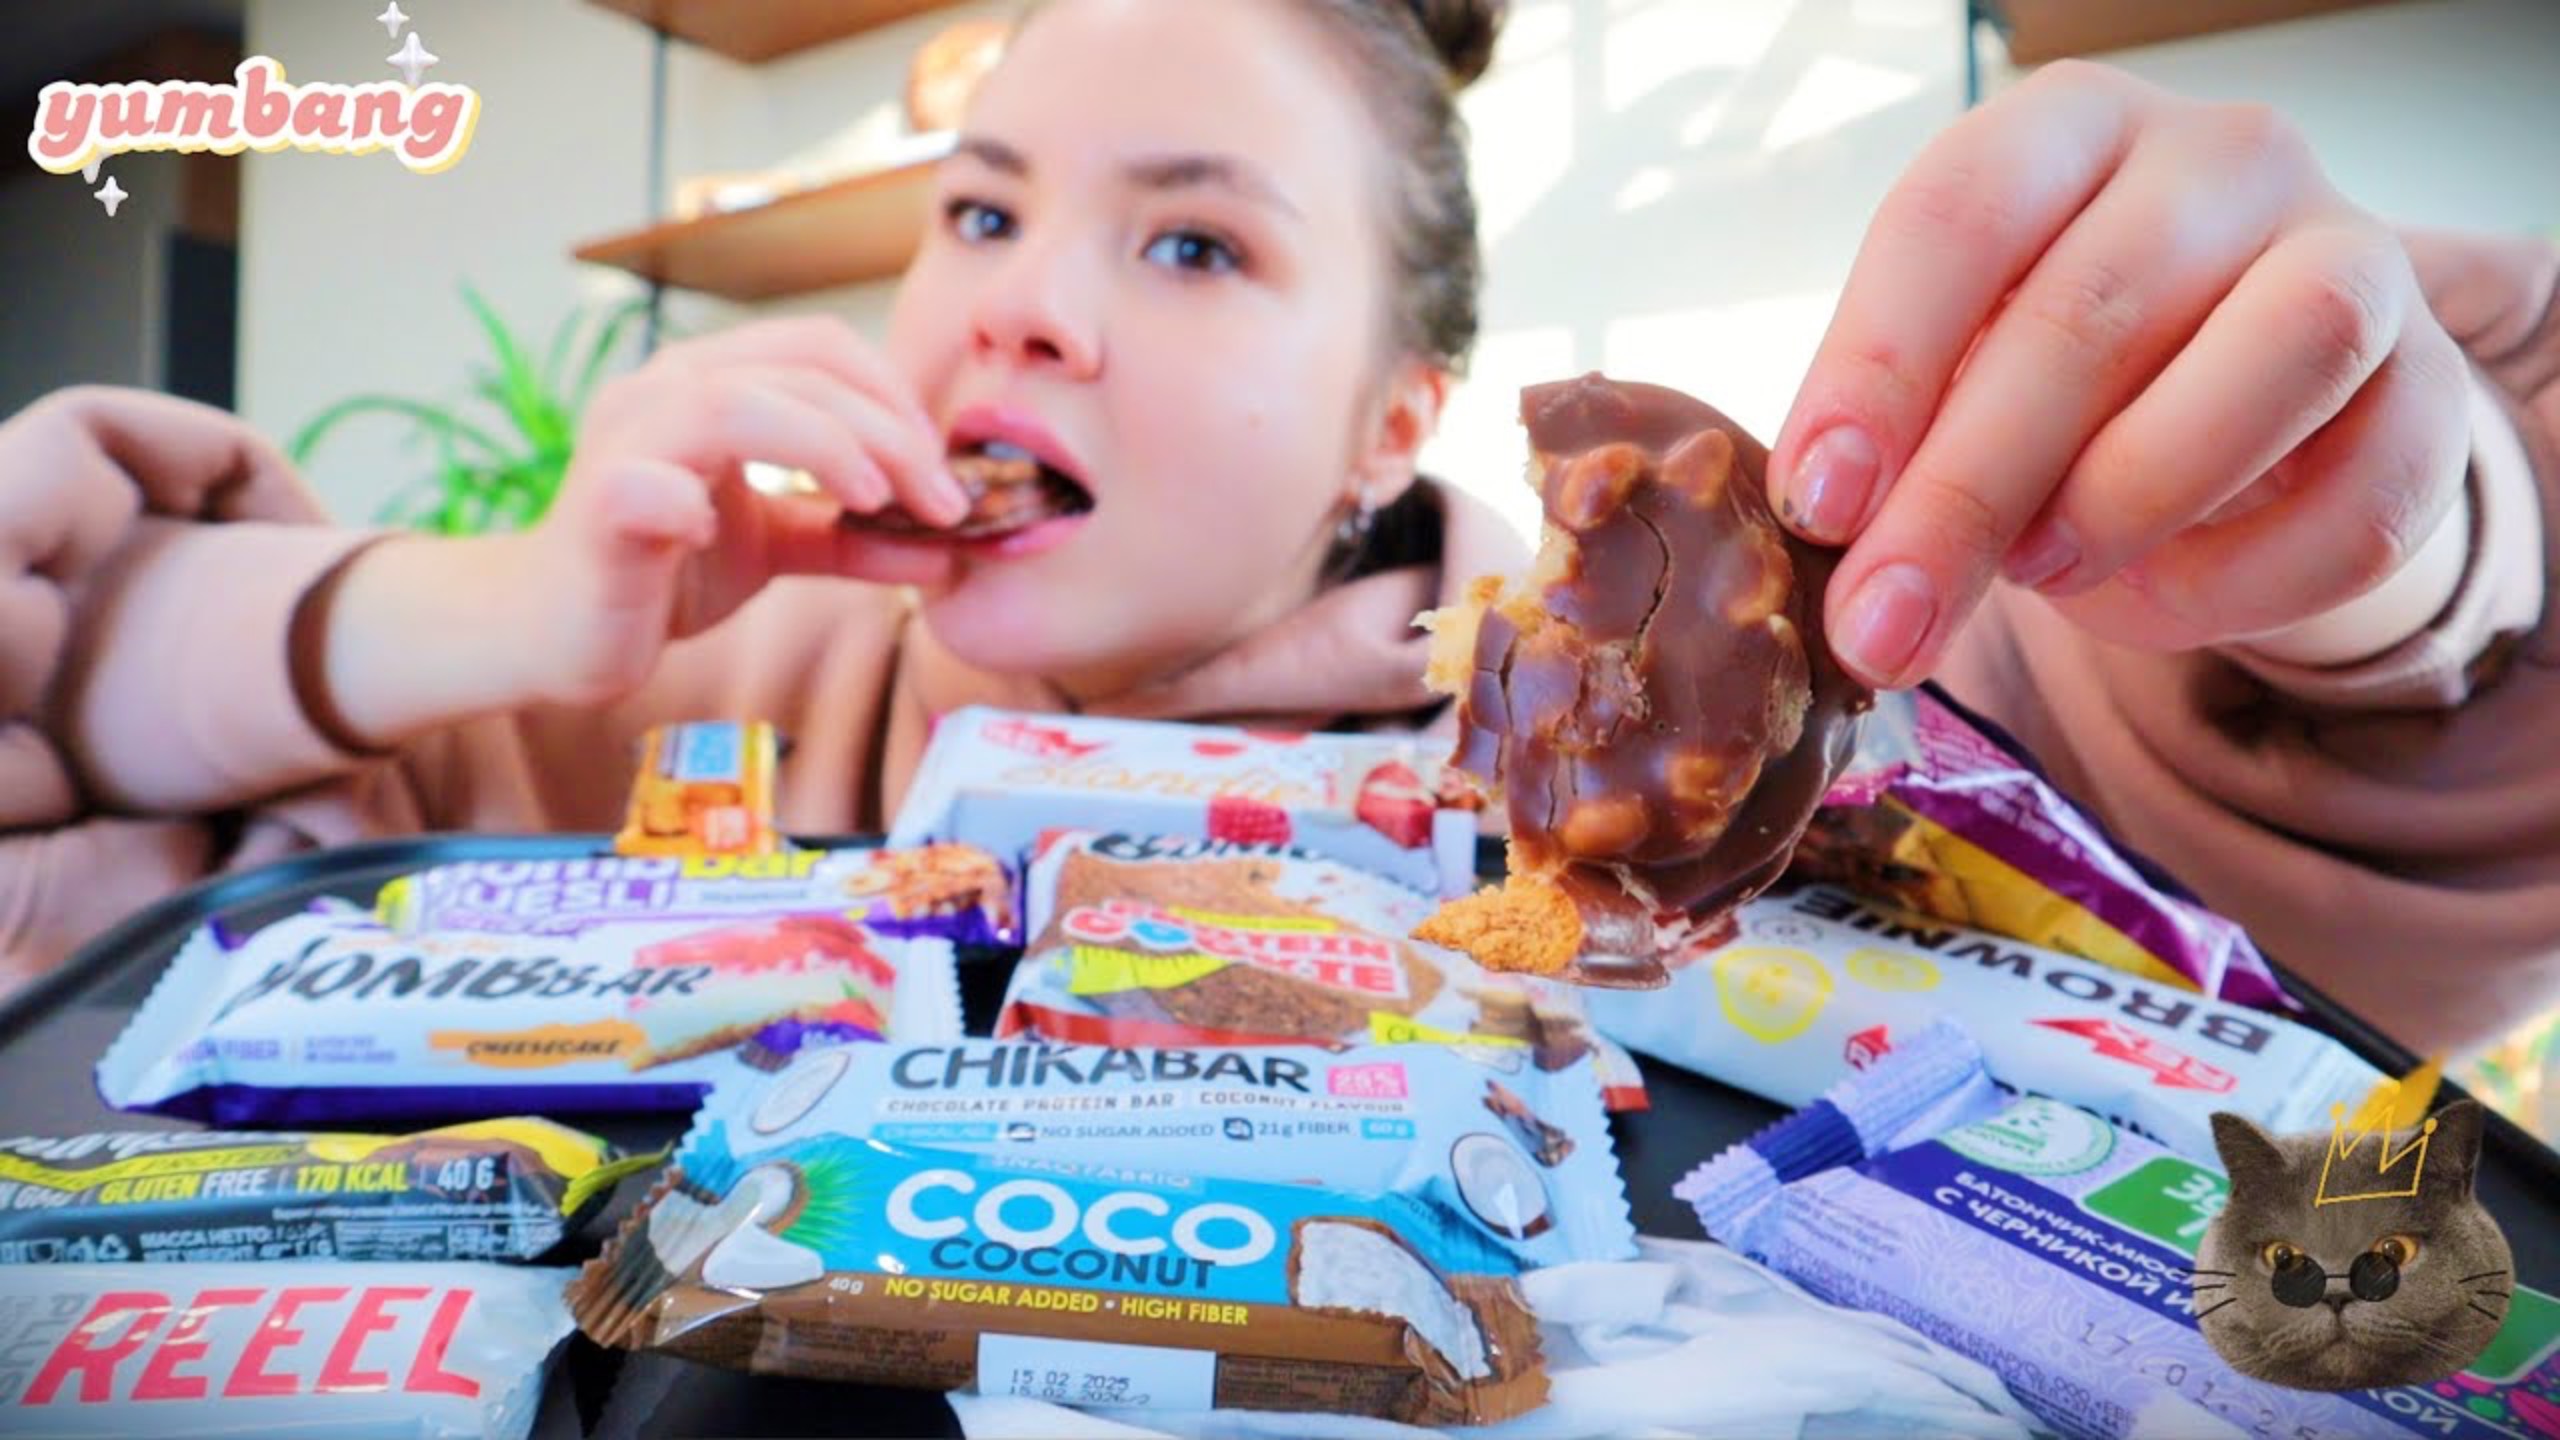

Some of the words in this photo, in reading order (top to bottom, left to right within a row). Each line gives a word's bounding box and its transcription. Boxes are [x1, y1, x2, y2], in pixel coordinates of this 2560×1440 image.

[1793, 884, 2276, 1056] BROWNIE
[890, 1044, 1311, 1093] CHIKABAR
[888, 1100, 1009, 1113] CHOCOLATE
[1022, 1097, 1117, 1112] PROTEIN
[1130, 1094, 1175, 1109] BAR
[1200, 1090, 1298, 1110] COCONUT
[1041, 1125, 1071, 1139] NO
[1075, 1124, 1143, 1139] SUGAR
[1147, 1122, 1216, 1138] ADDED
[1257, 1121, 1293, 1138] 21g
[1298, 1120, 1350, 1136] FIBER
[99, 1173, 201, 1206] GLUTEN
[202, 1167, 272, 1198] FREE
[295, 1164, 341, 1193] 170
[344, 1161, 409, 1192] KCAL
[885, 1169, 1277, 1267] COCO
[1934, 1186, 1964, 1206] С
[1967, 1199, 2162, 1297] ЧЕРНИКОЙ
[930, 1237, 1217, 1290] COCONUT
[885, 1277, 924, 1299] NO
[928, 1283, 1010, 1307] SUGAR
[1015, 1292, 1099, 1315] ADDED
[1120, 1298, 1183, 1322] HIGH
[1187, 1303, 1250, 1327] FIBER
[18, 1287, 482, 1406] REEEL
